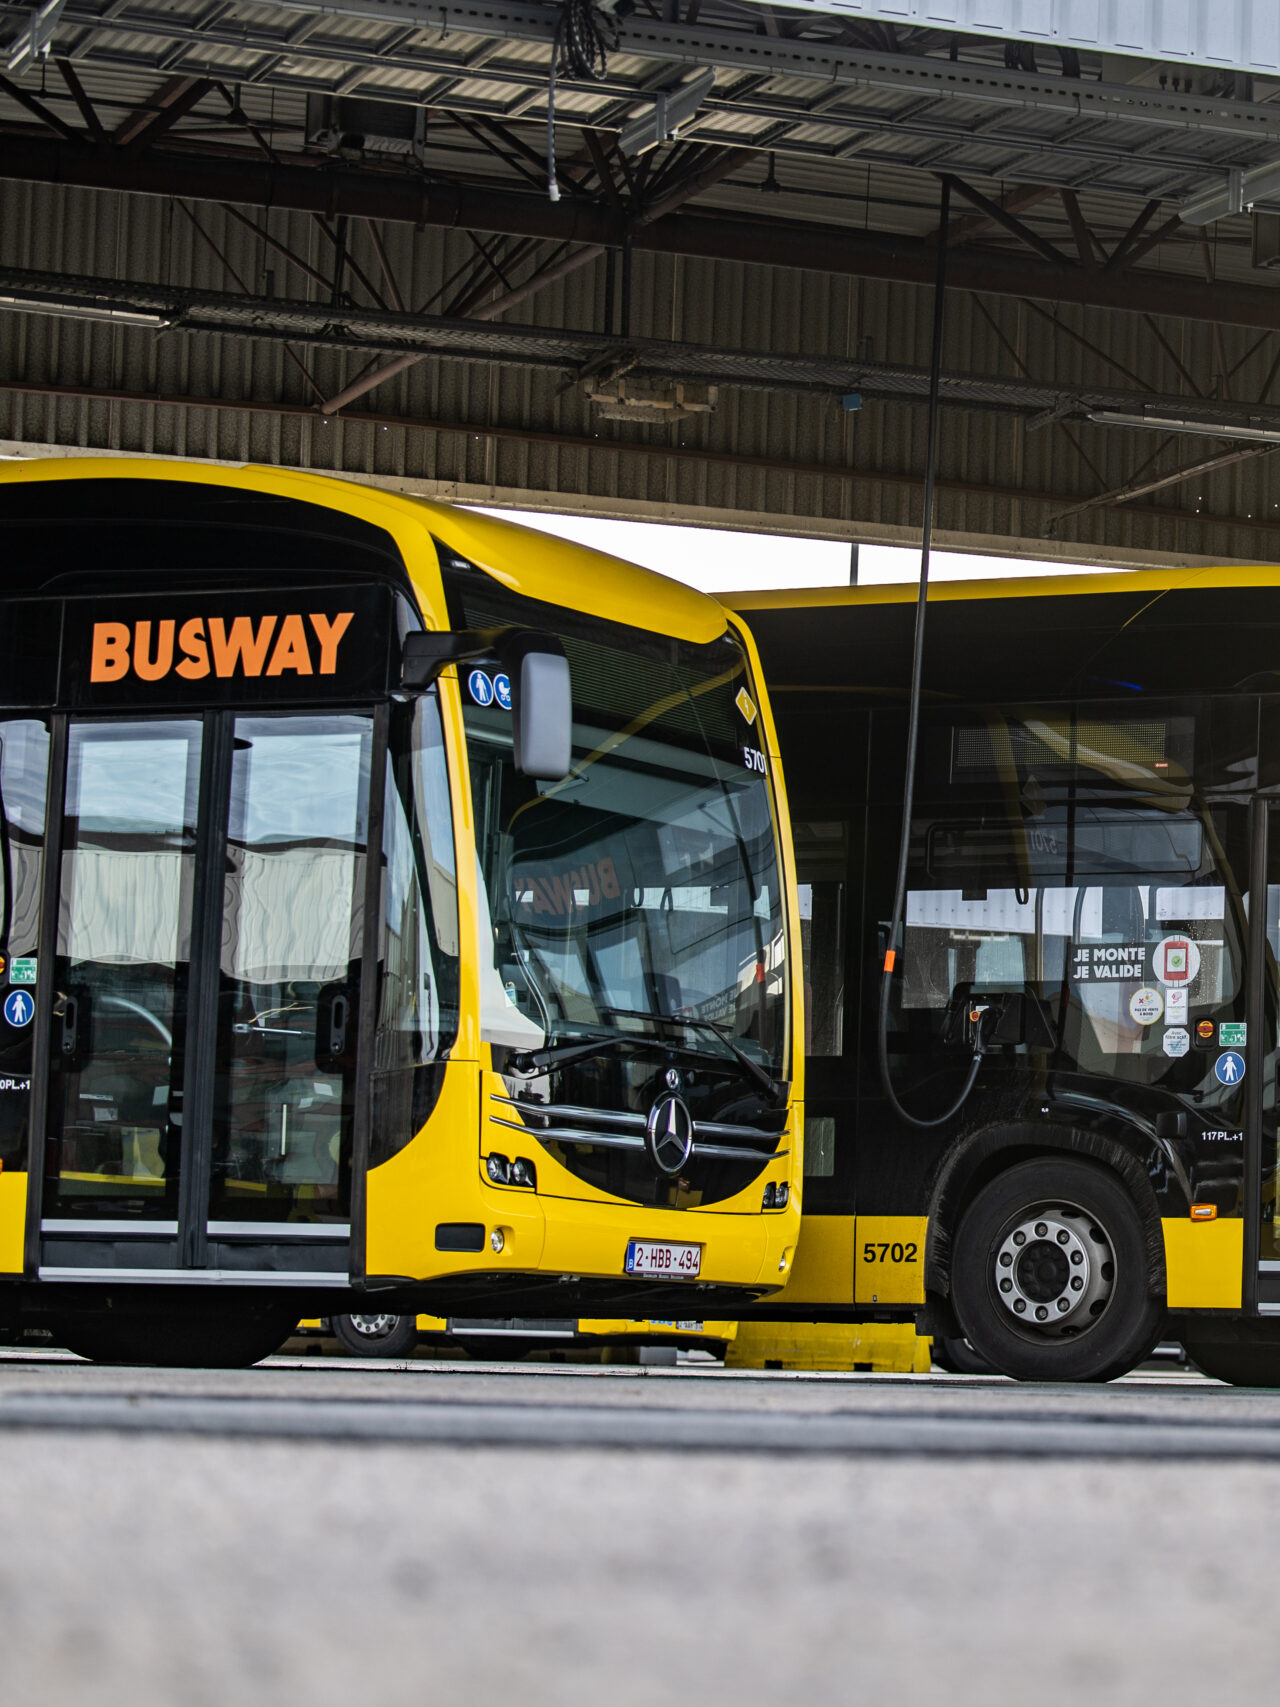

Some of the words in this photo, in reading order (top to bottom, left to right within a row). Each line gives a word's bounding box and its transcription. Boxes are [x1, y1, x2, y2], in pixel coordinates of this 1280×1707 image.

[90, 612, 355, 683] BUSWAY
[743, 746, 768, 775] 5701
[1073, 949, 1089, 962] JE
[1093, 947, 1146, 961] MONTE
[1073, 966, 1089, 979] JE
[1093, 964, 1142, 978] VALIDE
[1201, 1131, 1243, 1141] 117PL.+1
[636, 1248, 699, 1270] 2-HBB-494
[863, 1243, 918, 1263] 5702
